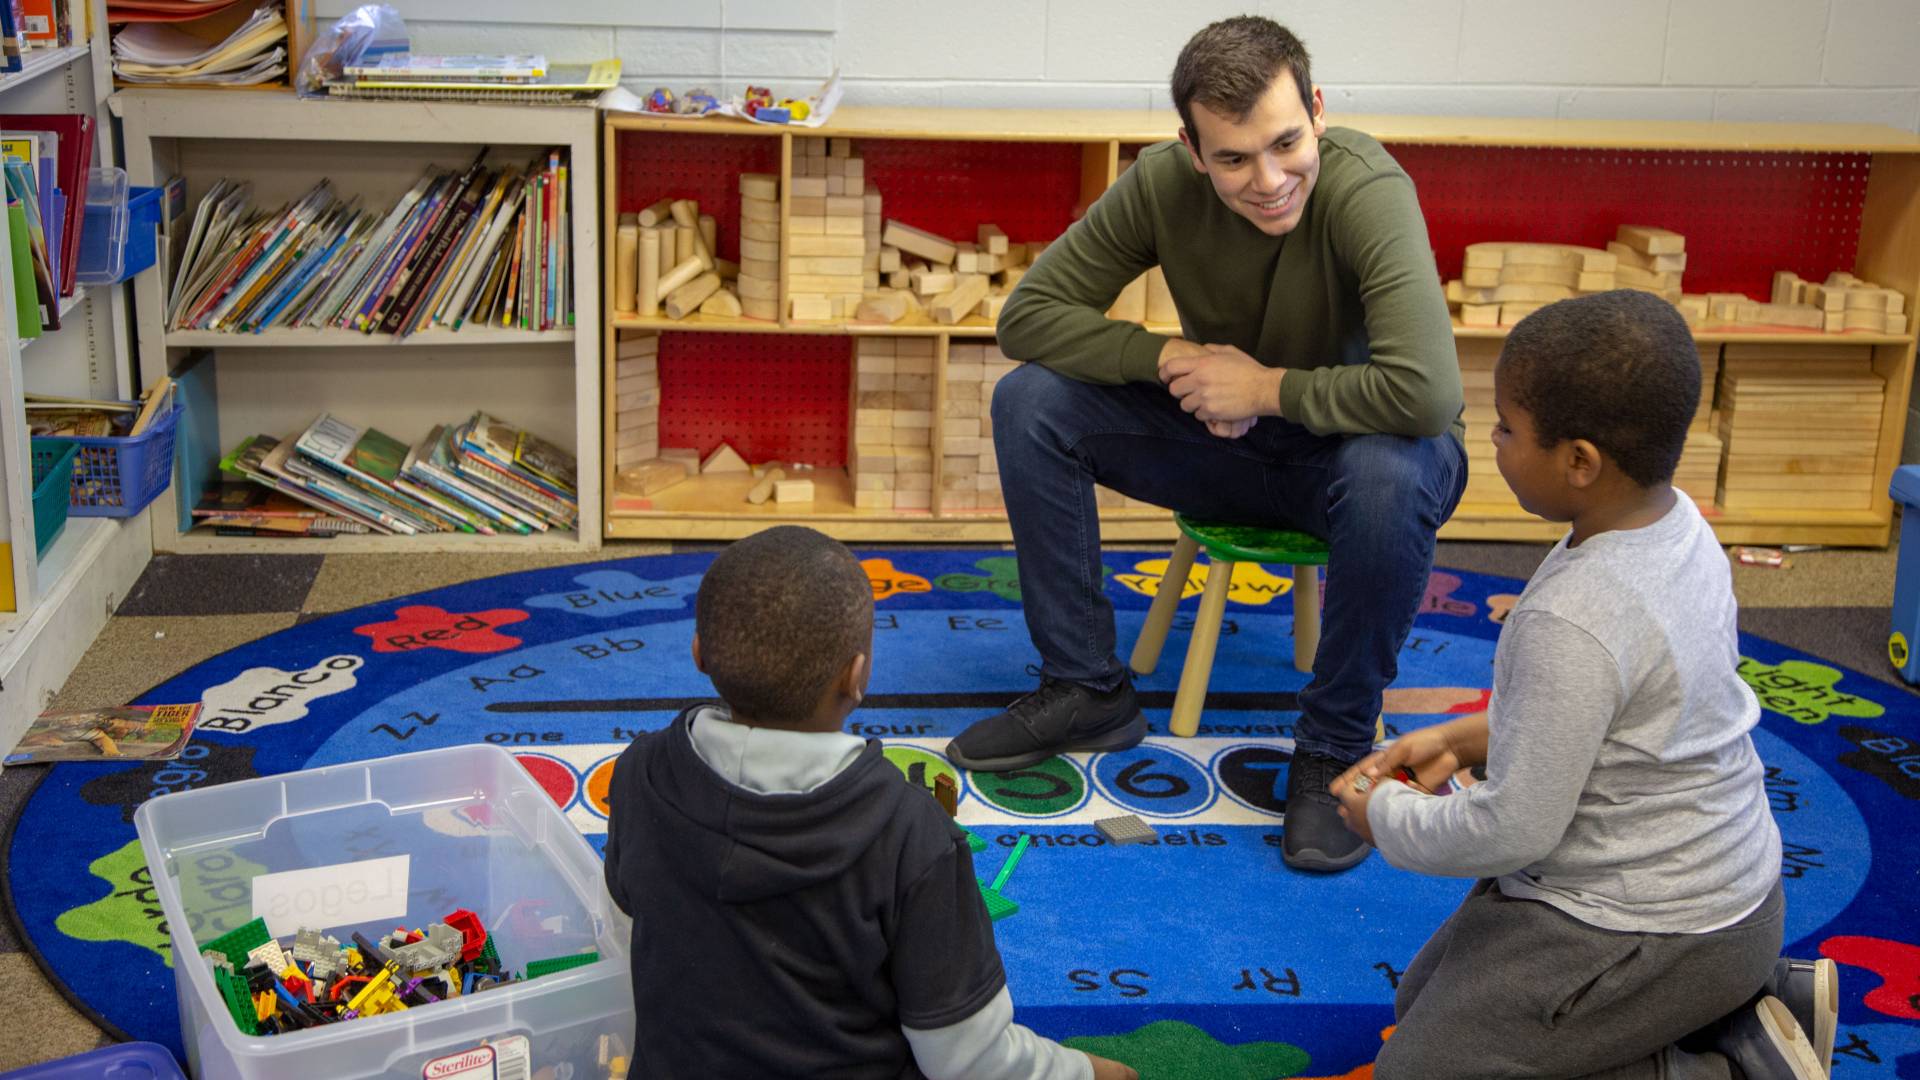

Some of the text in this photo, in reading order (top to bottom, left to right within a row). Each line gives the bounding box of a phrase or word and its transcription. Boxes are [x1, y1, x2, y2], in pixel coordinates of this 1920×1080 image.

[566, 582, 679, 611] Blue
[942, 574, 1018, 591] Gre
[1123, 578, 1284, 593] Yllw
[387, 615, 488, 651] Red
[949, 616, 1009, 631] Ee
[572, 636, 646, 661] Bb
[471, 663, 545, 693] Aa
[200, 655, 358, 732] Blanco
[1754, 687, 1821, 720] een
[484, 730, 565, 744] one
[850, 722, 933, 736] four
[150, 745, 210, 798] gro
[1861, 737, 1920, 779] Bla
[1115, 759, 1190, 798] 6
[432, 1053, 483, 1075] Sterilite
